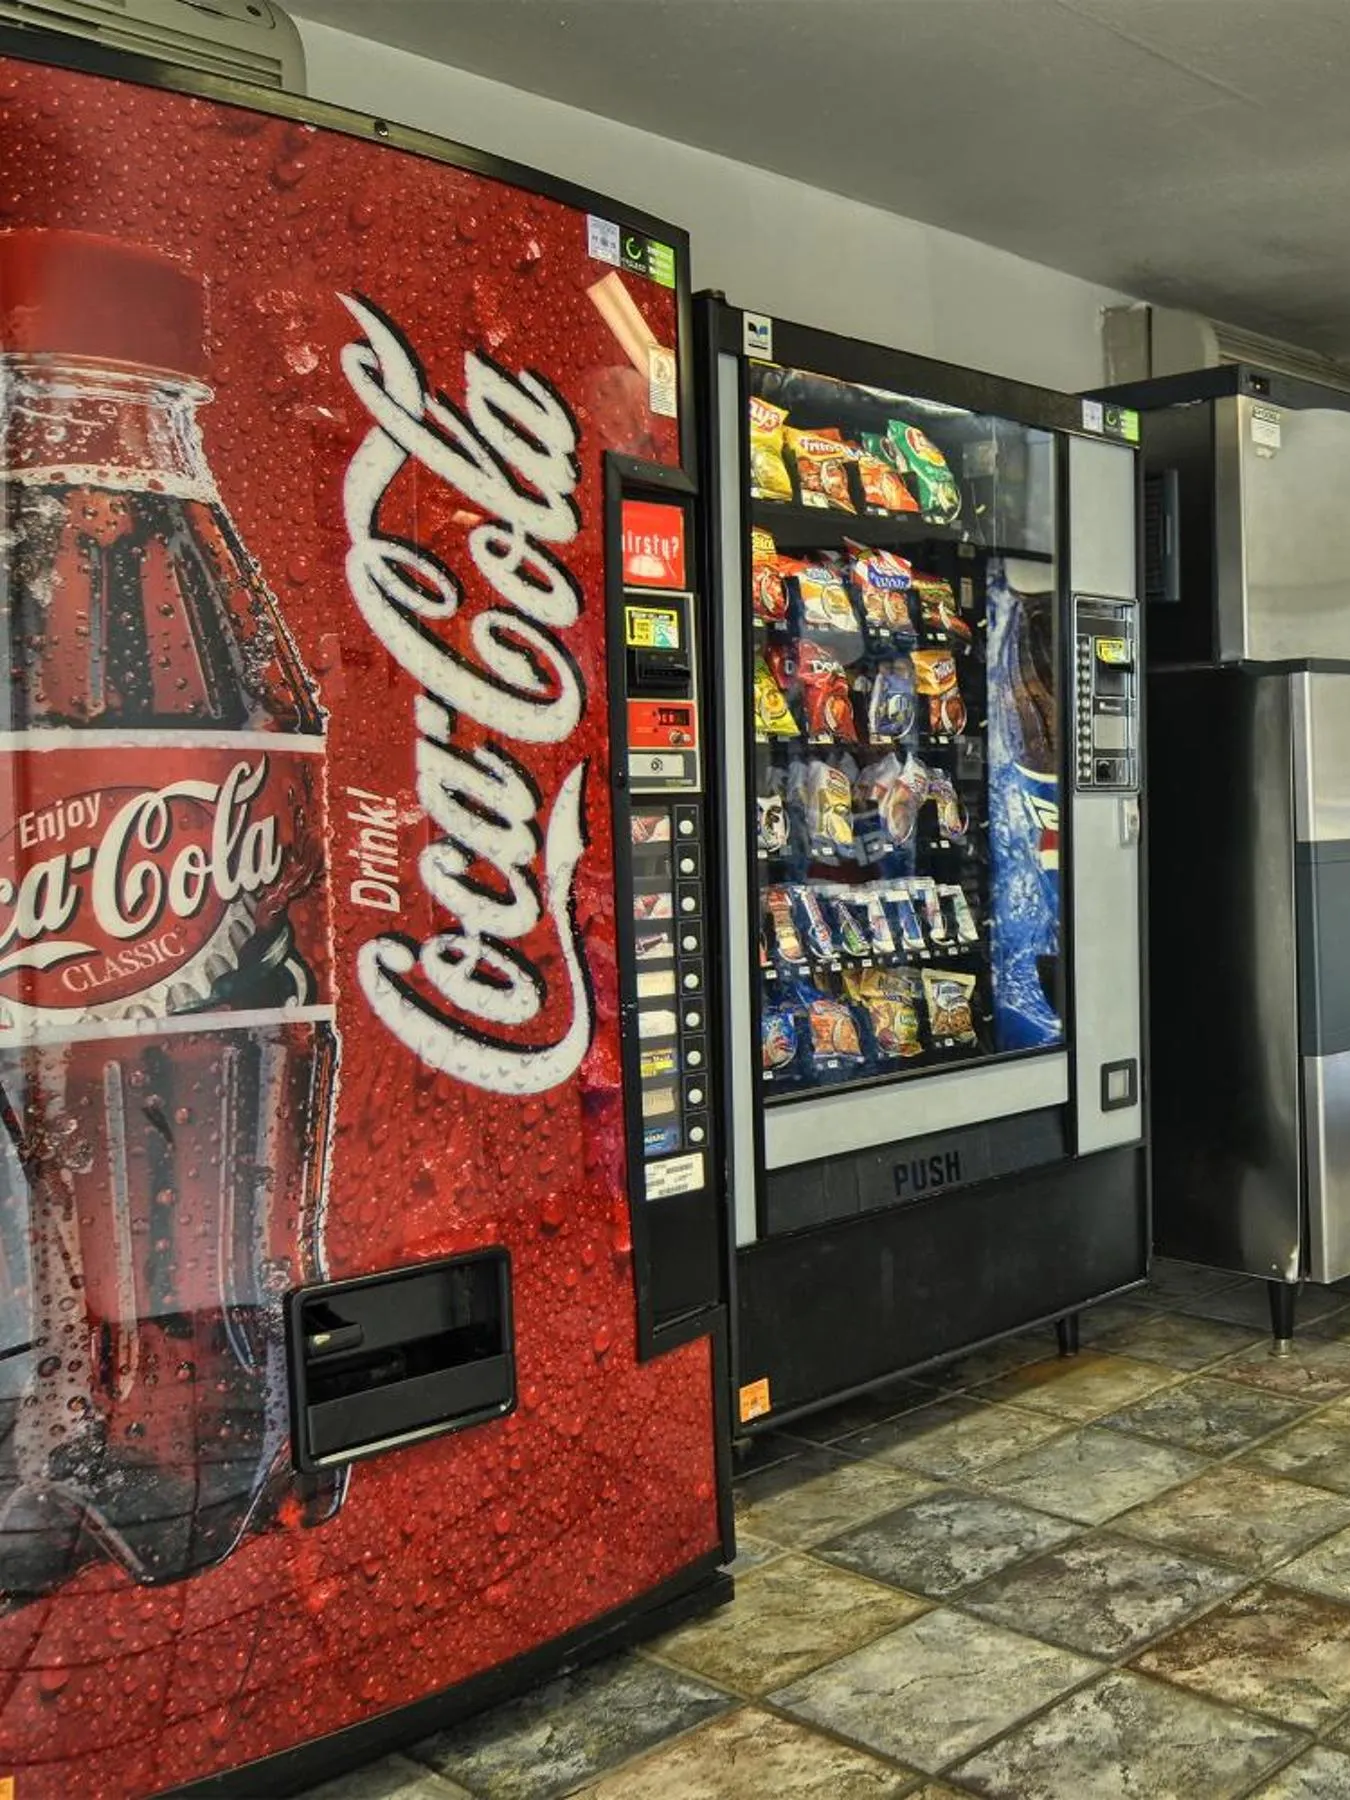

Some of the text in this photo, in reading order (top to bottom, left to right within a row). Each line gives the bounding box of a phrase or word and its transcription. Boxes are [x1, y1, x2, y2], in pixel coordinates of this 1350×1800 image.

[335, 290, 594, 1096] Coca-Cola
[19, 792, 101, 849] Enjoy
[346, 786, 402, 913] Drink!
[61, 931, 185, 993] CLASSIC
[893, 1150, 961, 1196] PUSH
